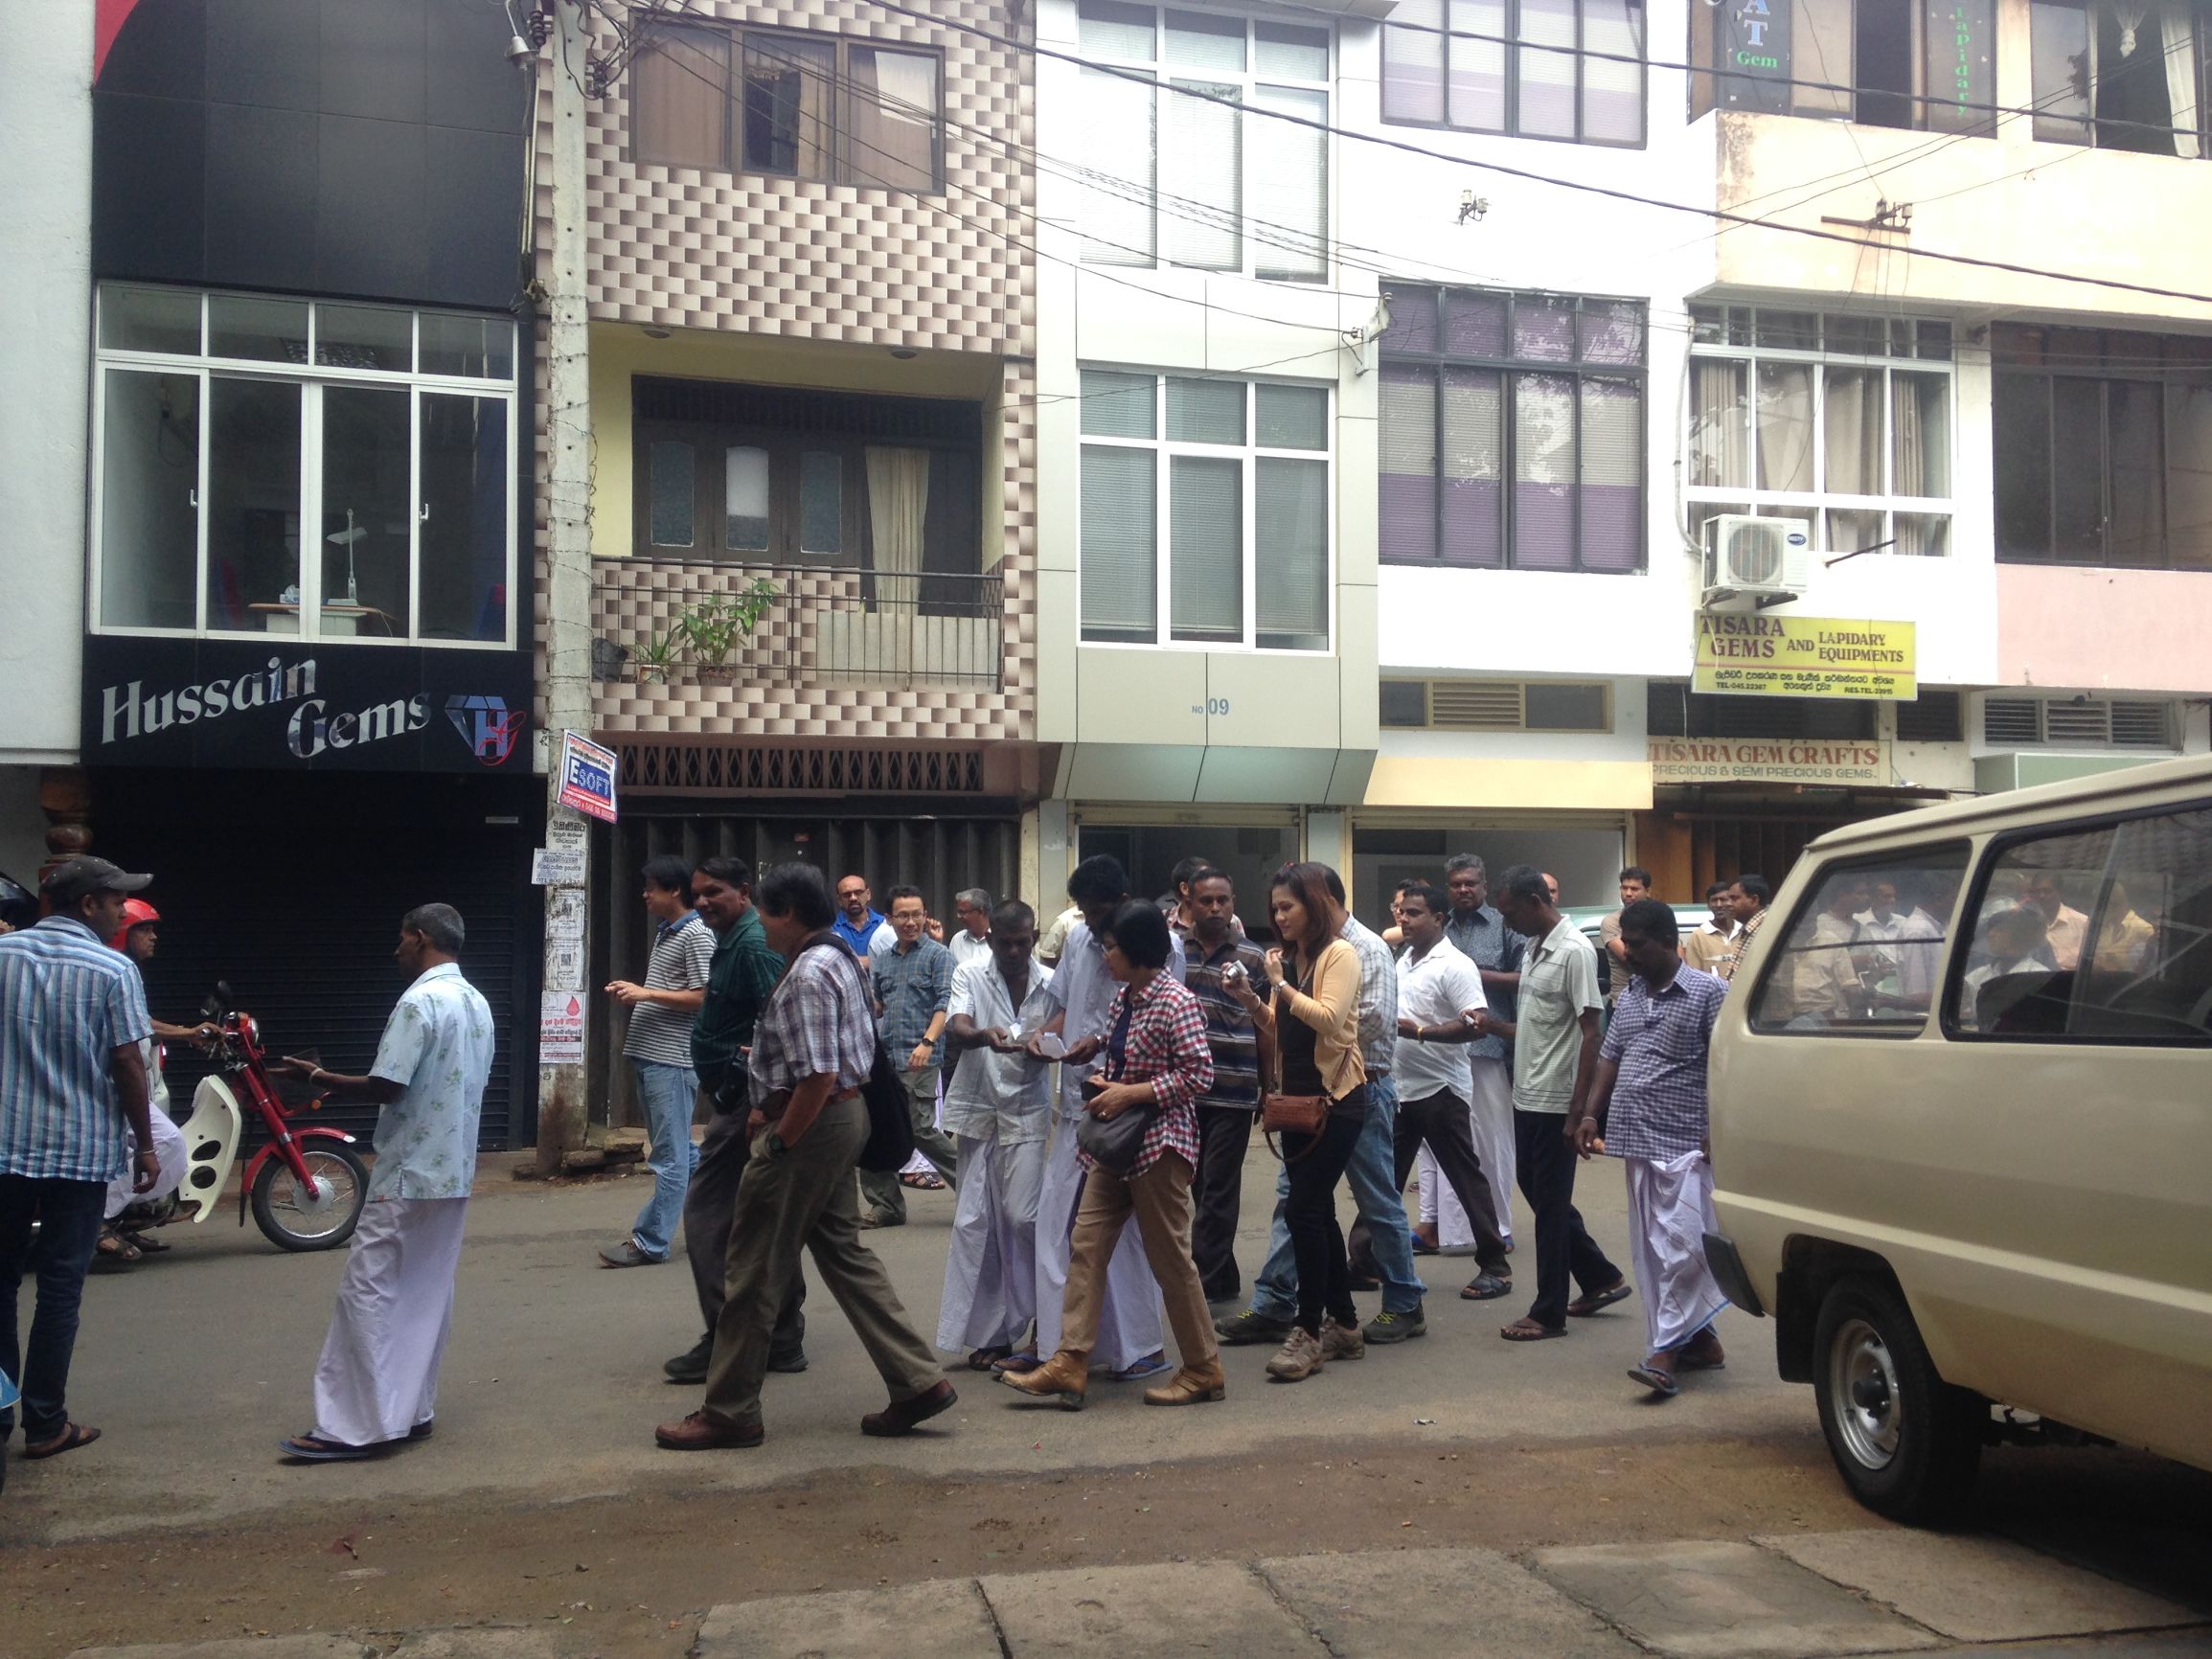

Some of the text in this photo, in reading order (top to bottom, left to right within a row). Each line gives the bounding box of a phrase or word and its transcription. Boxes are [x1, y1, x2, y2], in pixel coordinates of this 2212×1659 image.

[1737, 51, 1779, 69] Gem
[1700, 615, 1786, 637] TISARA
[1711, 638, 1775, 658] GEMS
[1787, 639, 1814, 651] AND
[1818, 631, 1885, 647] LAPIDARY
[1818, 648, 1904, 663] EQUIPMENTS
[101, 656, 317, 745] Hussain
[1208, 697, 1229, 716] 09
[287, 691, 431, 759] Gems
[1649, 742, 1879, 765] TISARA GEM CRAFTS
[1653, 764, 1717, 776] PRECIOUS
[1720, 765, 1729, 776] &
[1732, 766, 1763, 777] SEMI
[1767, 767, 1833, 778] PRECIOUS
